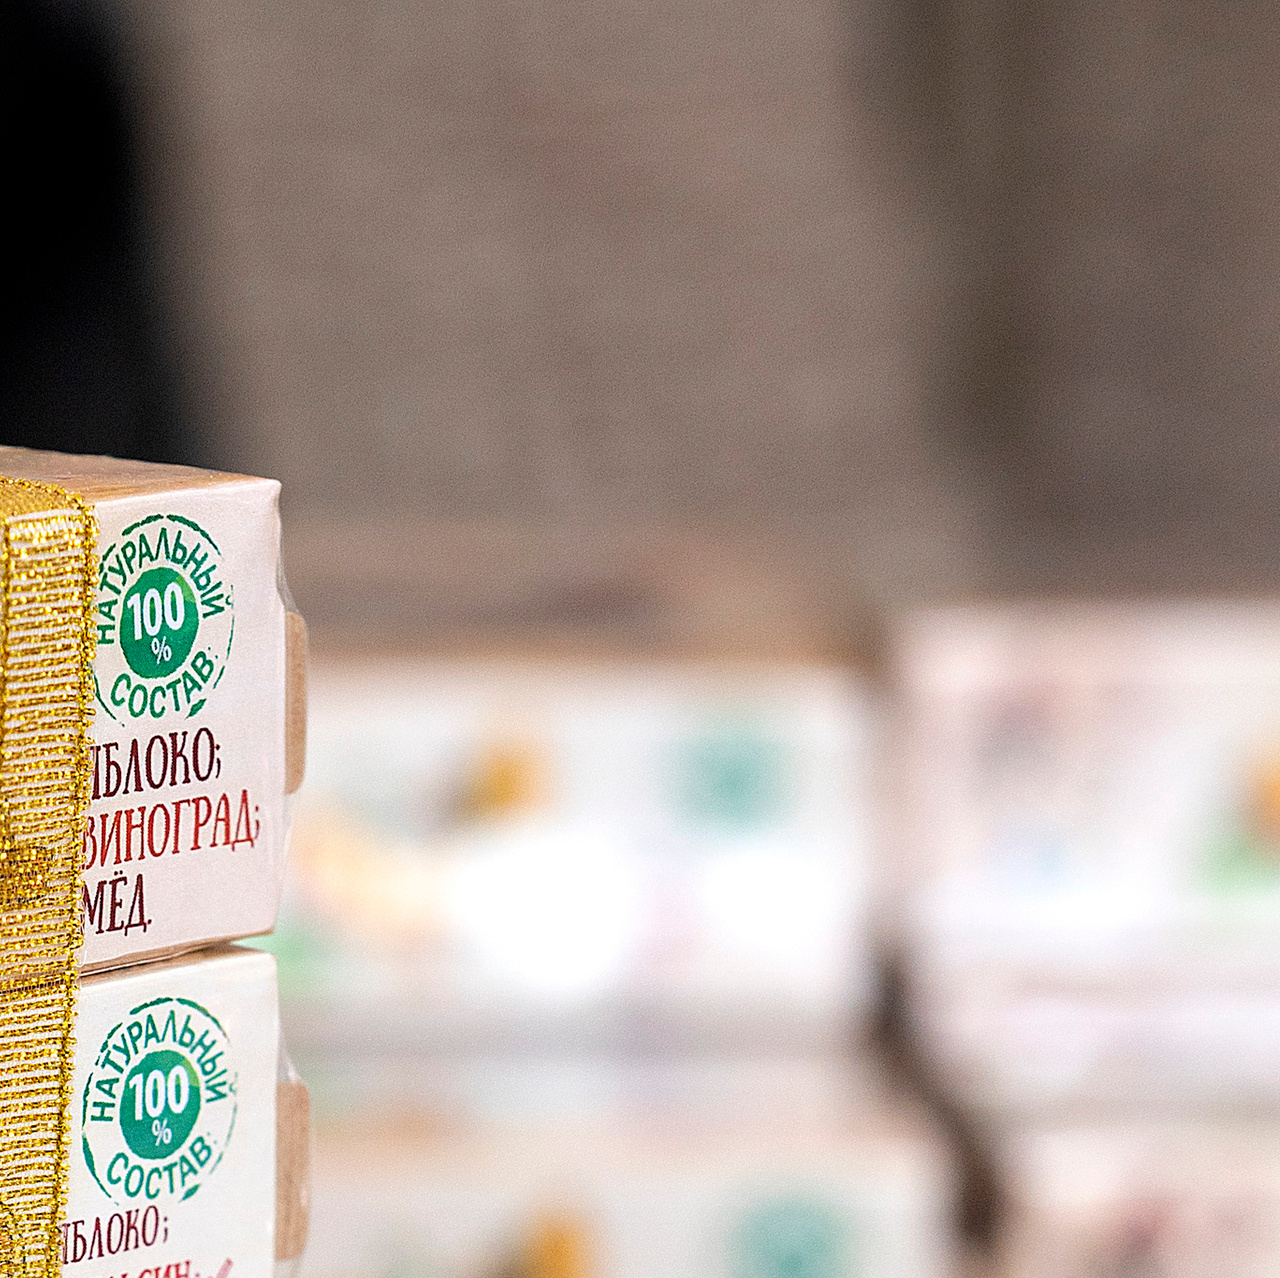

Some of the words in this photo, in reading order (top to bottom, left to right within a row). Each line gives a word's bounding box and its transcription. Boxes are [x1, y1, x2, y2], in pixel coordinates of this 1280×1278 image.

[96, 527, 234, 645] НАТУРАЛЬНЫЙ
[126, 582, 186, 640] 100
[150, 638, 173, 665] %
[110, 652, 216, 720] СОСТАВ
[80, 789, 261, 870] ВИНОГРАД;
[90, 1009, 238, 1122] НАТУРАЛЬНЫЙ
[129, 1065, 190, 1120] 100
[152, 1117, 173, 1147] %
[107, 1136, 212, 1200] СОСТАВ
